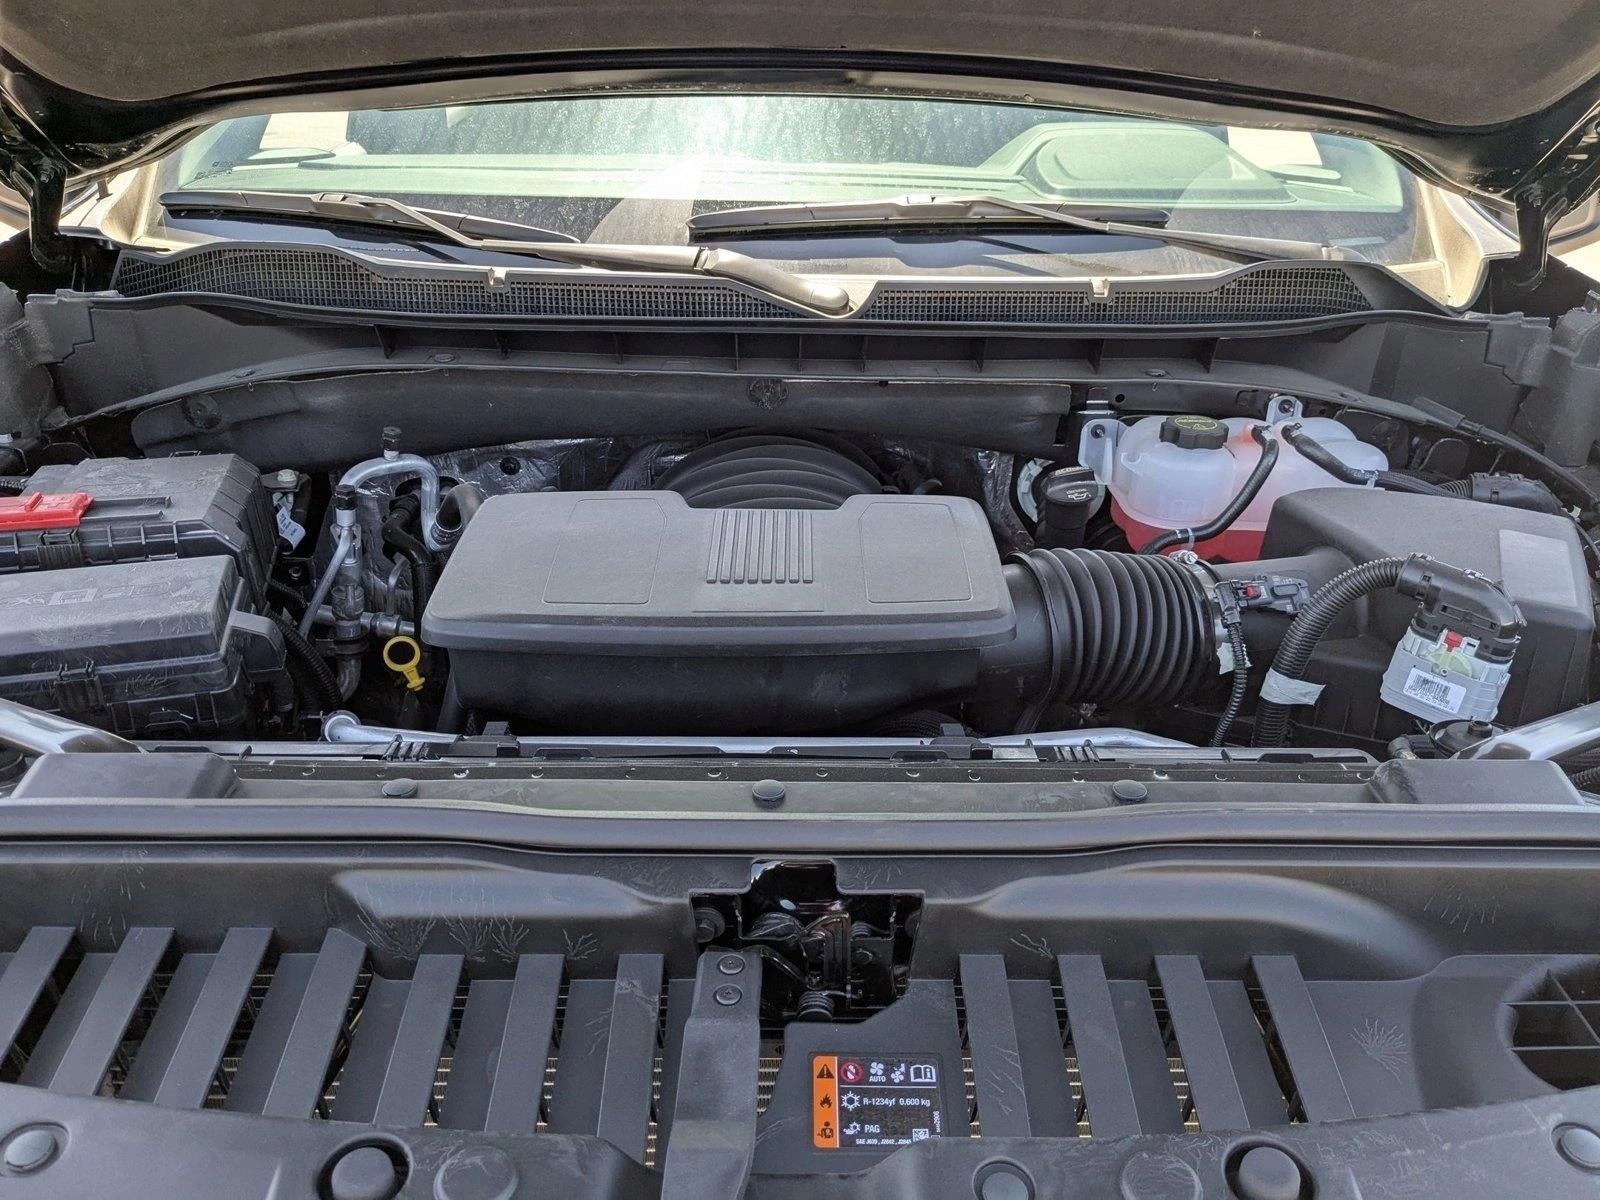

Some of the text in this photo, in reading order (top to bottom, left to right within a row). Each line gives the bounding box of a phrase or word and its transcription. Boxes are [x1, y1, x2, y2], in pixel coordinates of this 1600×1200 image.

[863, 1098, 931, 1107] R-1234yf 0.600 kg
[864, 1125, 880, 1133] PAG
